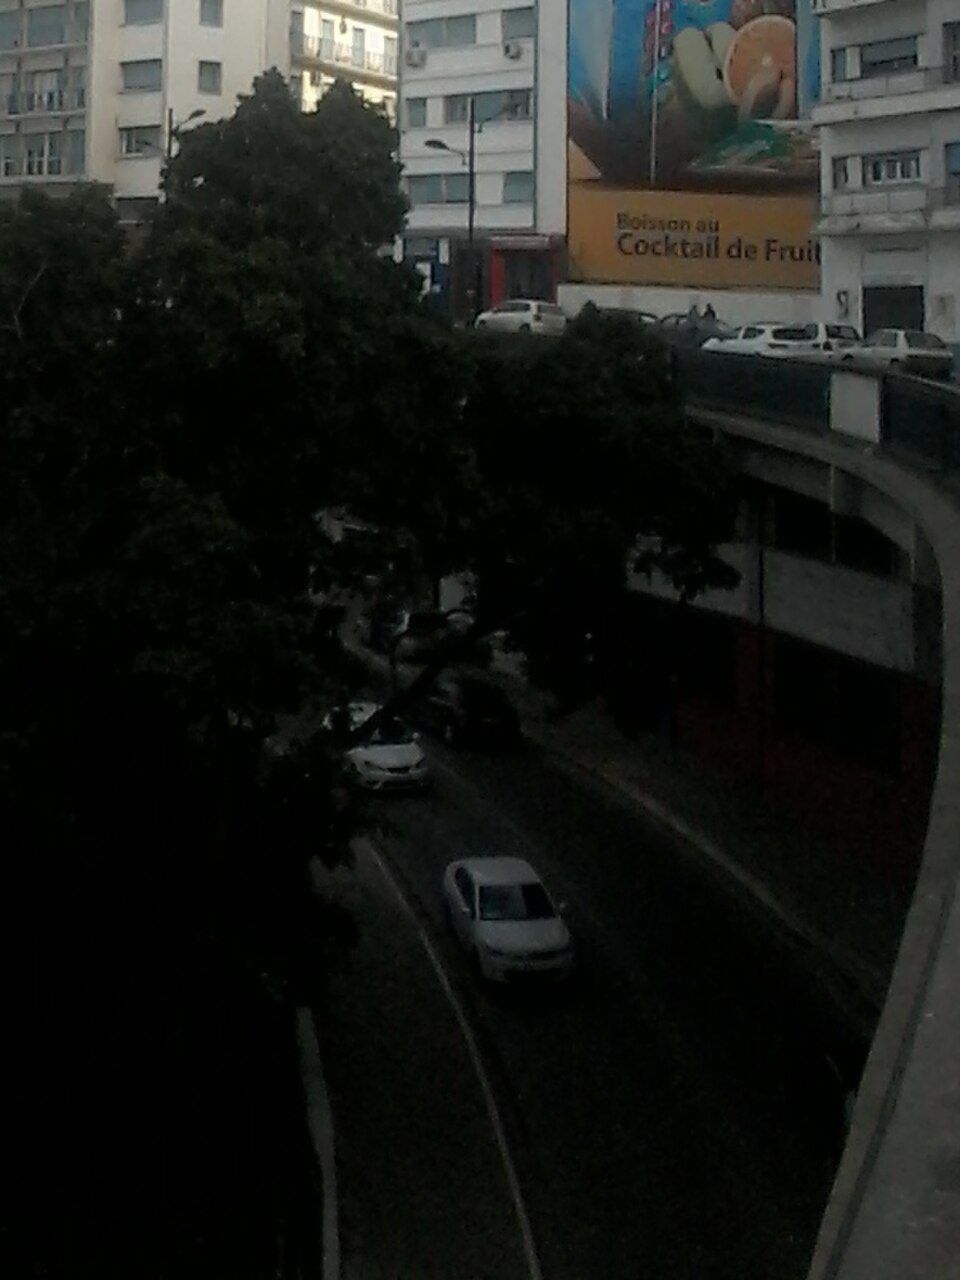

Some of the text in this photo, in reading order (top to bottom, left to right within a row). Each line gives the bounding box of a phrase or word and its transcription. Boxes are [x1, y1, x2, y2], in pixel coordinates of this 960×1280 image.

[617, 213, 720, 232] Boisson au
[617, 232, 720, 258] Cocktail
[727, 238, 757, 260] de
